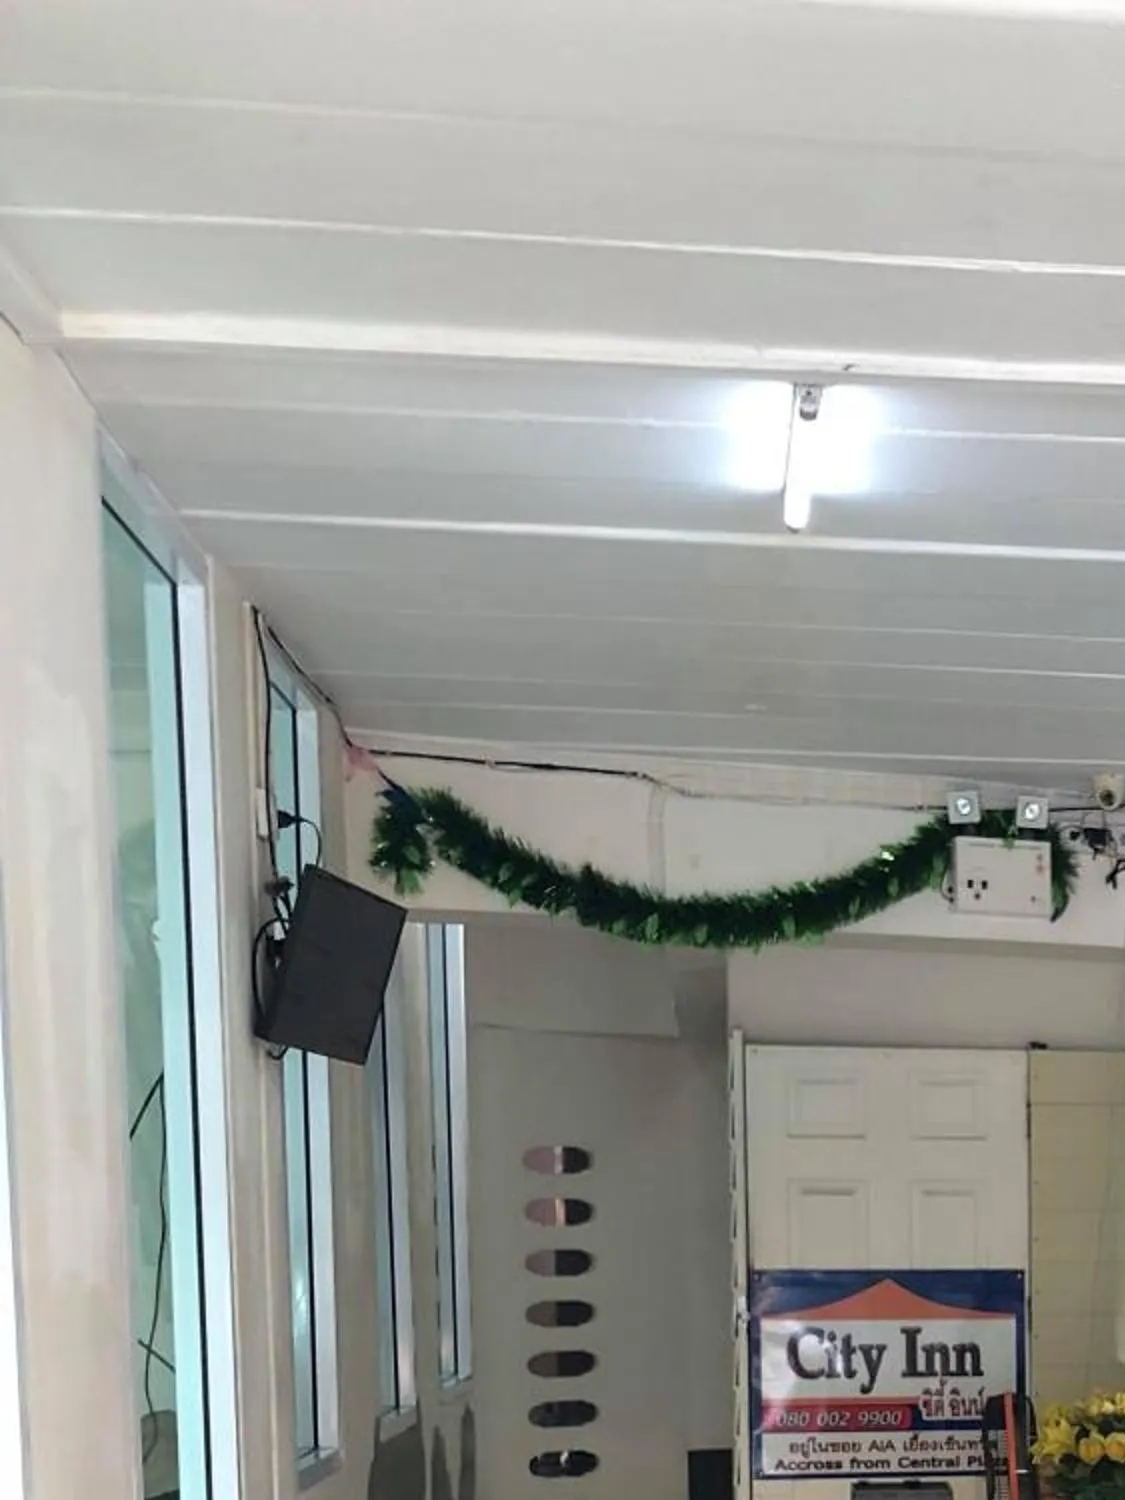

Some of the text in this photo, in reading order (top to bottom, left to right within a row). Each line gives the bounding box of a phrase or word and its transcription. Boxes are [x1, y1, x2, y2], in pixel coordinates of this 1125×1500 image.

[786, 1327, 984, 1395] City Inn
[776, 1409, 902, 1426] 080 002 9900
[775, 1458, 843, 1471] Accross
[849, 1456, 891, 1469] from
[897, 1456, 961, 1469] Central
